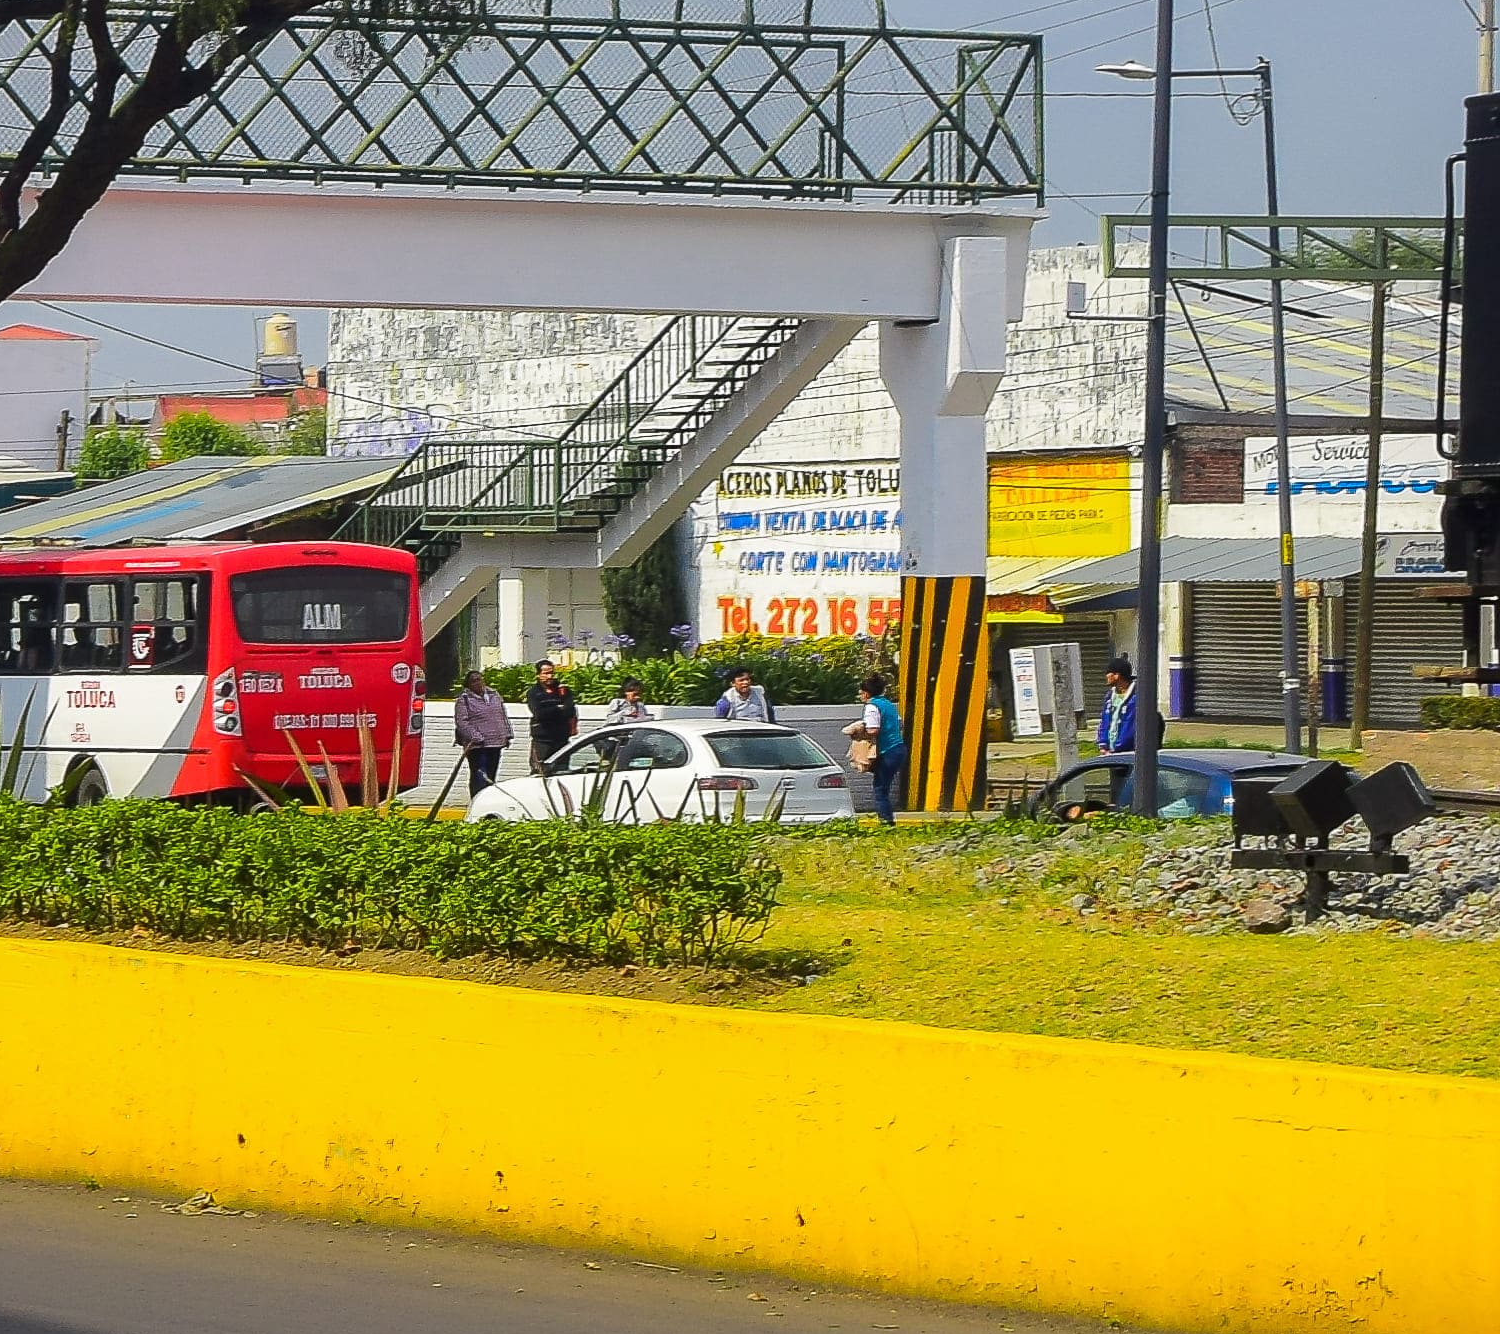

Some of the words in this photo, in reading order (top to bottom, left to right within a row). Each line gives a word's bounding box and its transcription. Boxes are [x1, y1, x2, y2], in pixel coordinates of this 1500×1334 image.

[717, 471, 772, 496] ACEROS
[776, 471, 828, 495] PLANOS
[717, 597, 759, 634] Tel.
[766, 597, 818, 635] 272
[828, 597, 858, 636] 16
[298, 675, 353, 689] TOLUCA
[66, 690, 116, 708] TOLUCA
